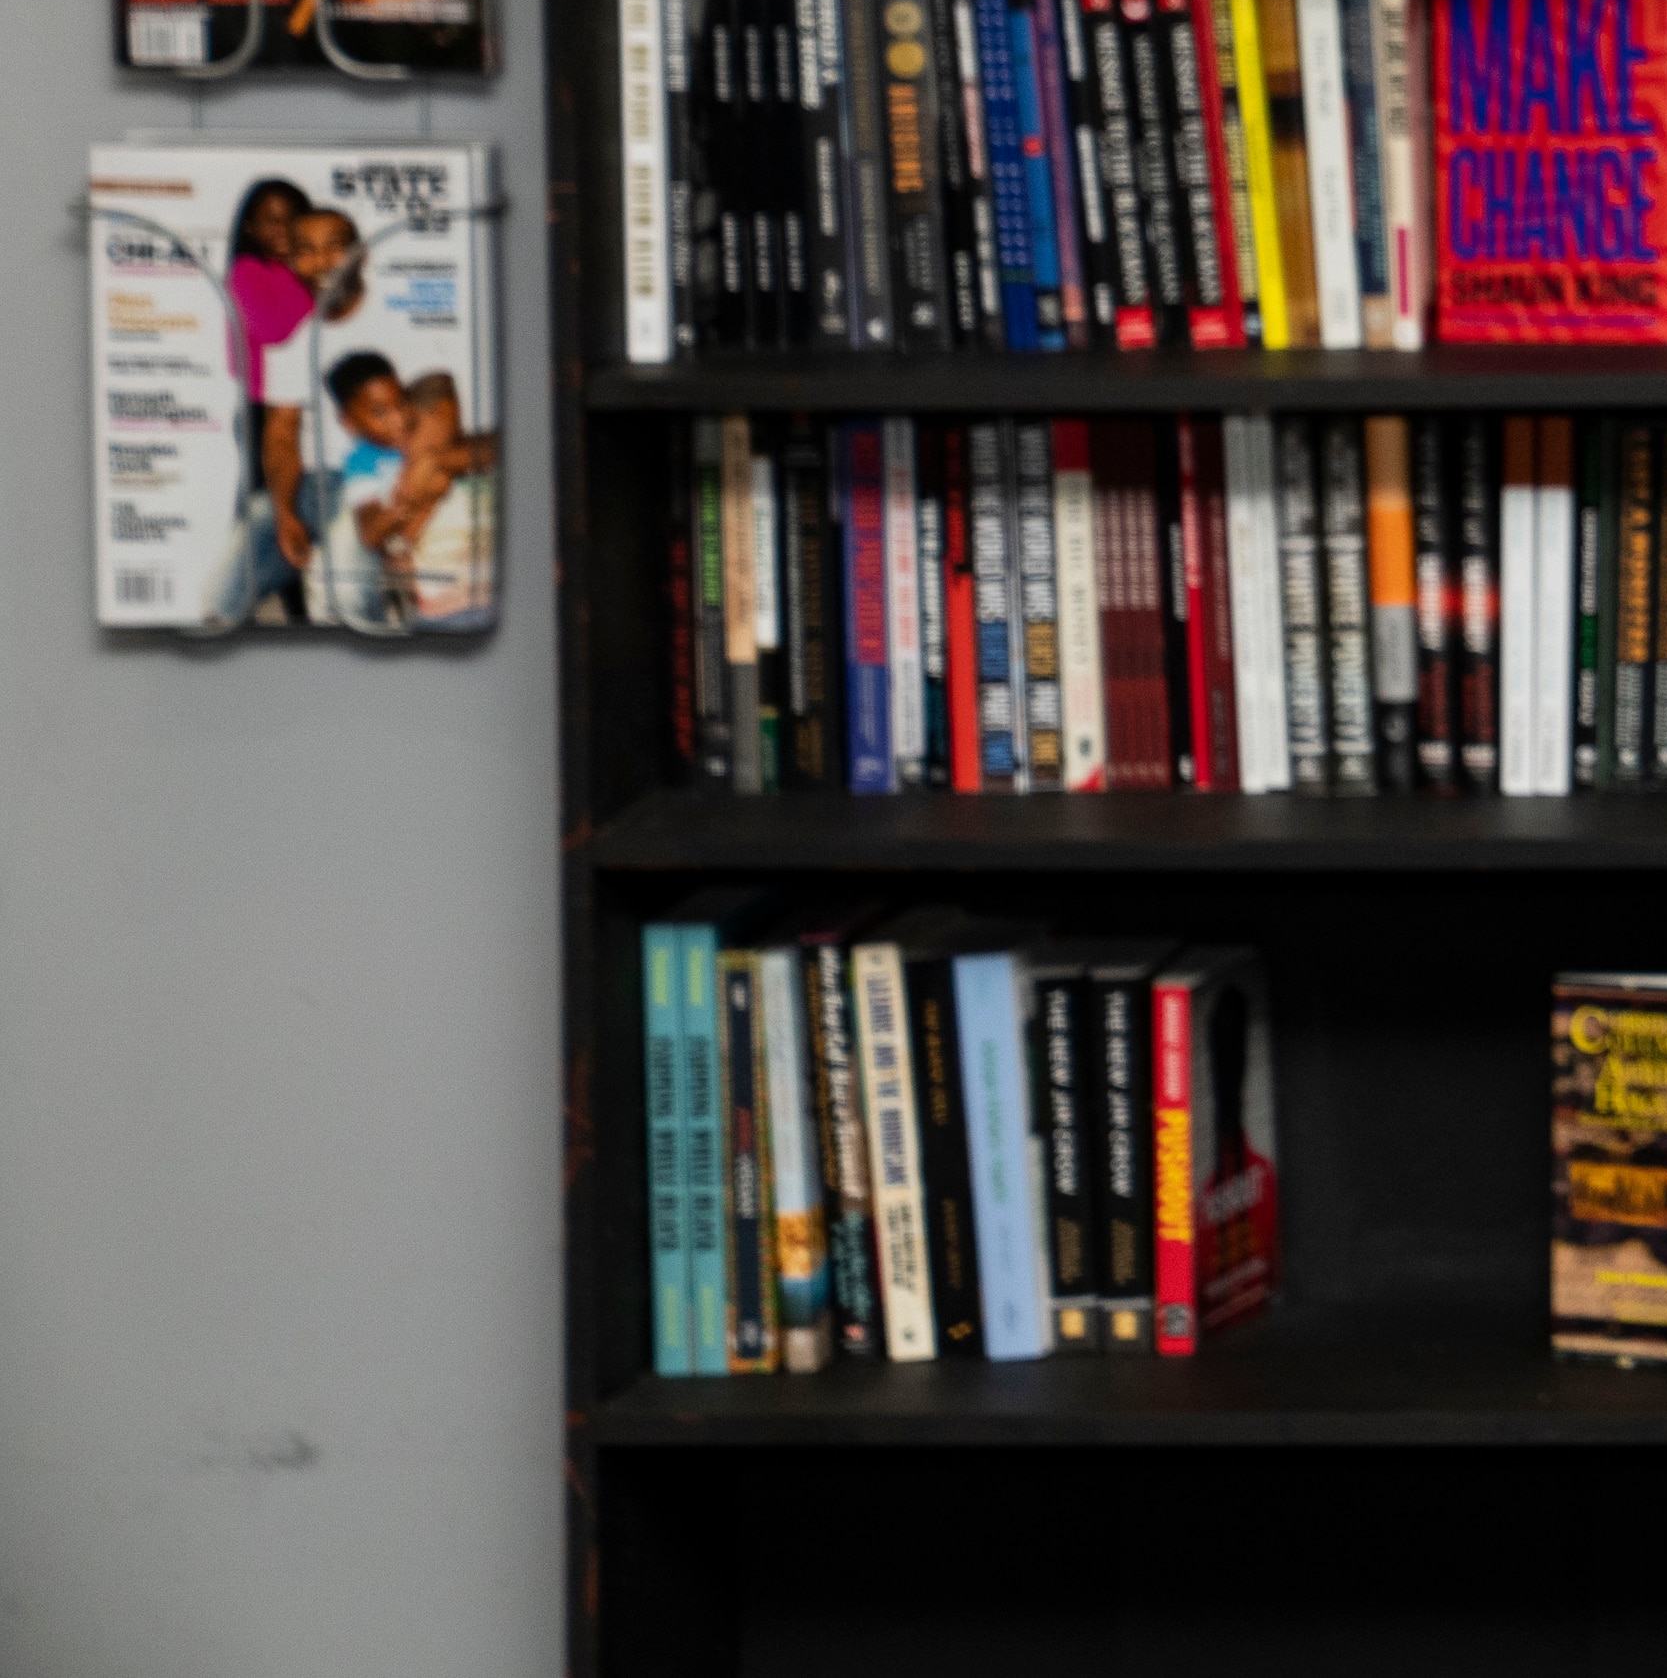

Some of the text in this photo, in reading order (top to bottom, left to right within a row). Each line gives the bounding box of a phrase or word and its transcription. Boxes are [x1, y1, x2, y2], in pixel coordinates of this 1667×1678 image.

[1449, 144, 1657, 262] CHANGE
[1451, 269, 1657, 309] SHAUN KING
[1156, 1109, 1193, 1243] PUSHOUT
